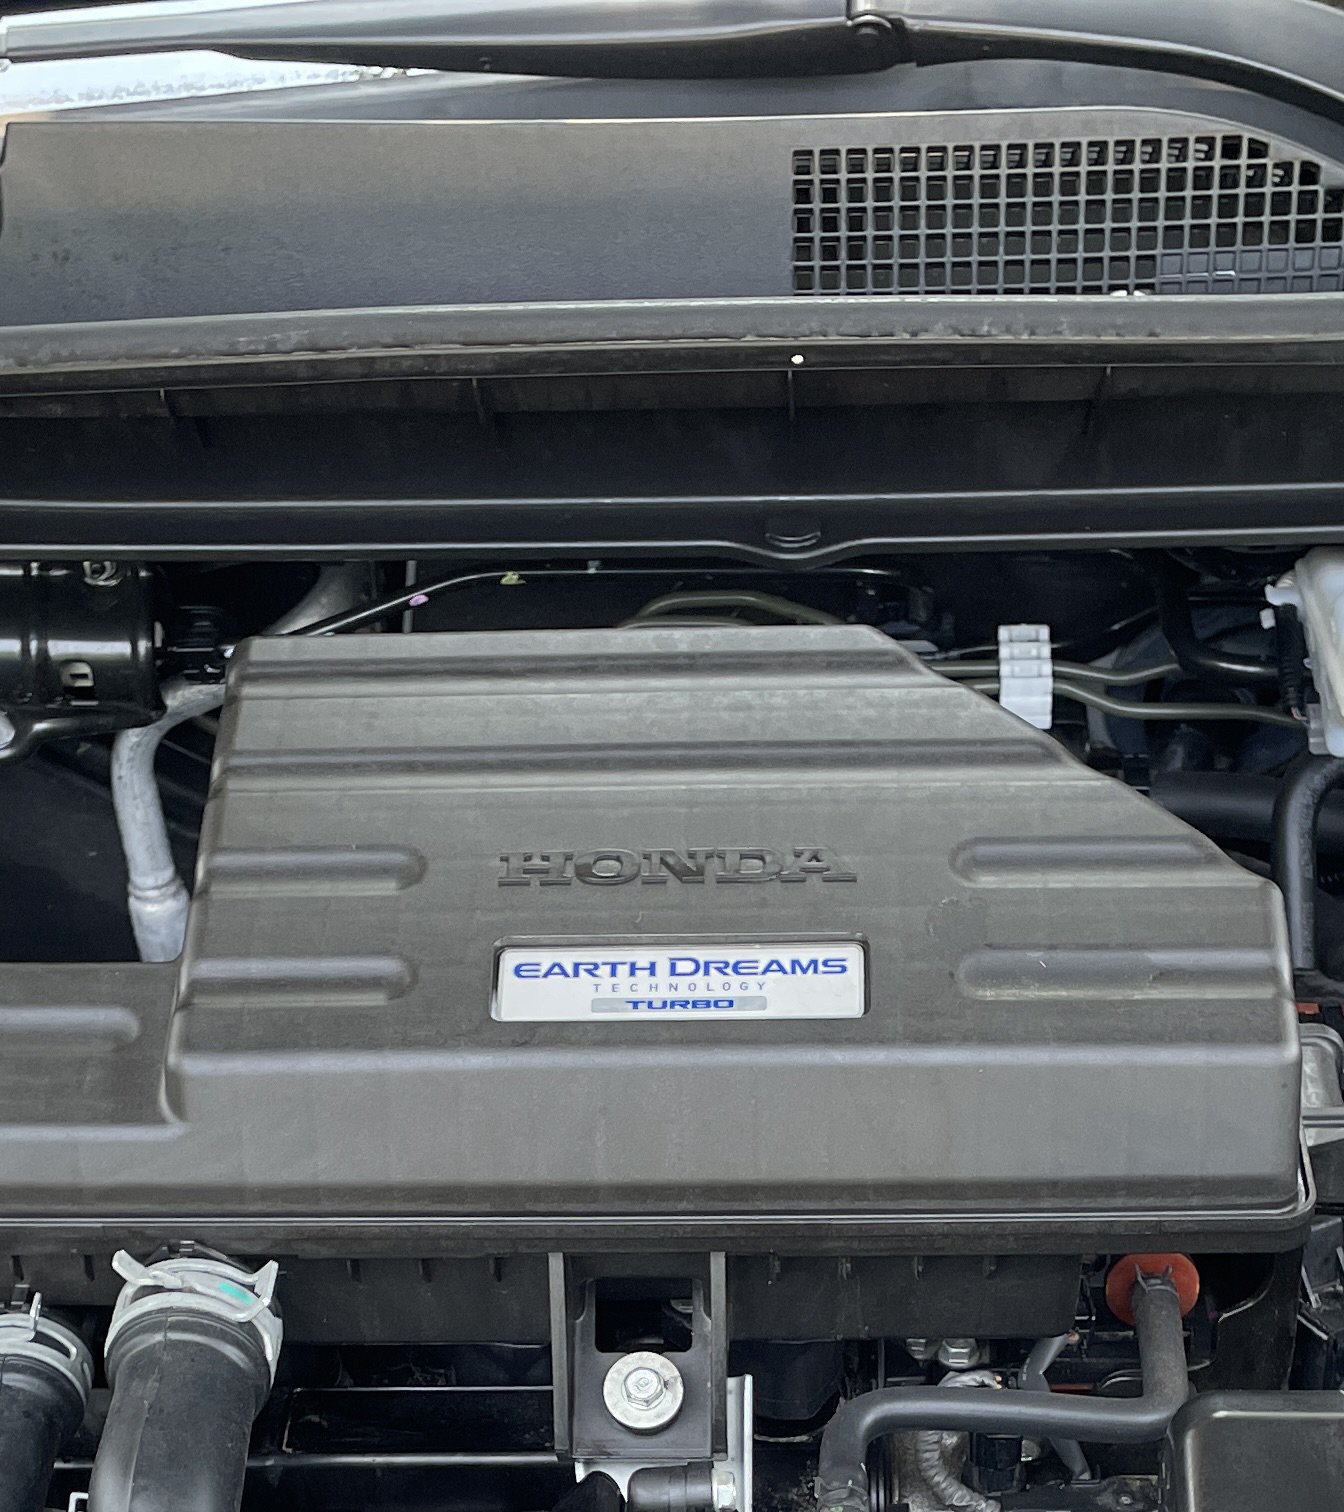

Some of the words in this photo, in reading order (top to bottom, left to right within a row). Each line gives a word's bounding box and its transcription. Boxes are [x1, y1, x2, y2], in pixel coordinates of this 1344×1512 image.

[498, 846, 857, 887] HONDA
[513, 961, 656, 979] EARTH
[669, 957, 848, 977] DREAMS
[594, 982, 766, 993] TECHNOLOGY
[626, 1000, 734, 1010] TURBO
